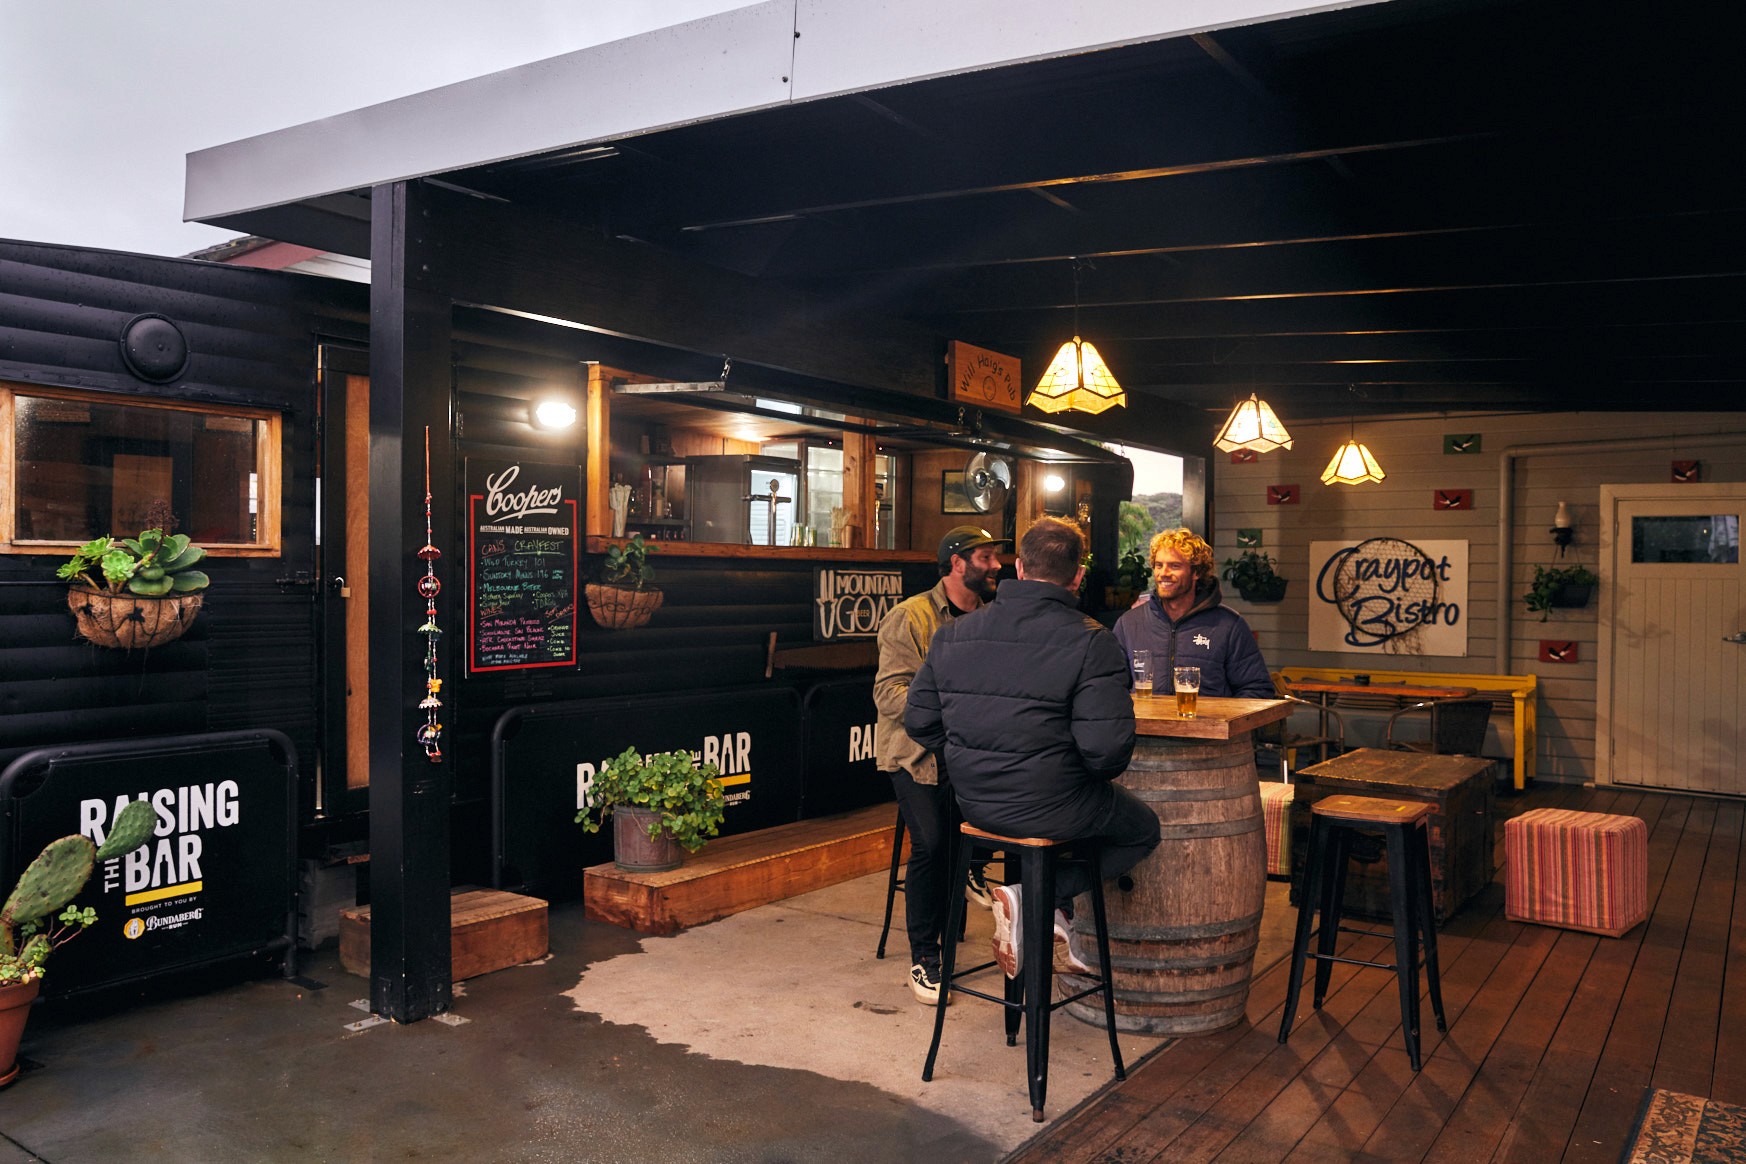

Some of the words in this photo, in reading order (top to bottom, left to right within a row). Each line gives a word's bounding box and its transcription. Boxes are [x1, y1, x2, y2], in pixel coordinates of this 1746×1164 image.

[960, 362, 976, 392] Will
[485, 466, 562, 521] Coopers
[505, 525, 524, 535] MADE
[547, 527, 569, 535] OWNED
[836, 574, 903, 595] MOUNTAIN
[1316, 547, 1451, 604] Craypot
[1344, 594, 1460, 647] Bistro
[704, 732, 751, 776] BAR
[80, 780, 240, 848] RSING
[125, 834, 203, 893] BAR
[131, 903, 162, 914] BROUGHT
[168, 922, 183, 930] RUM
